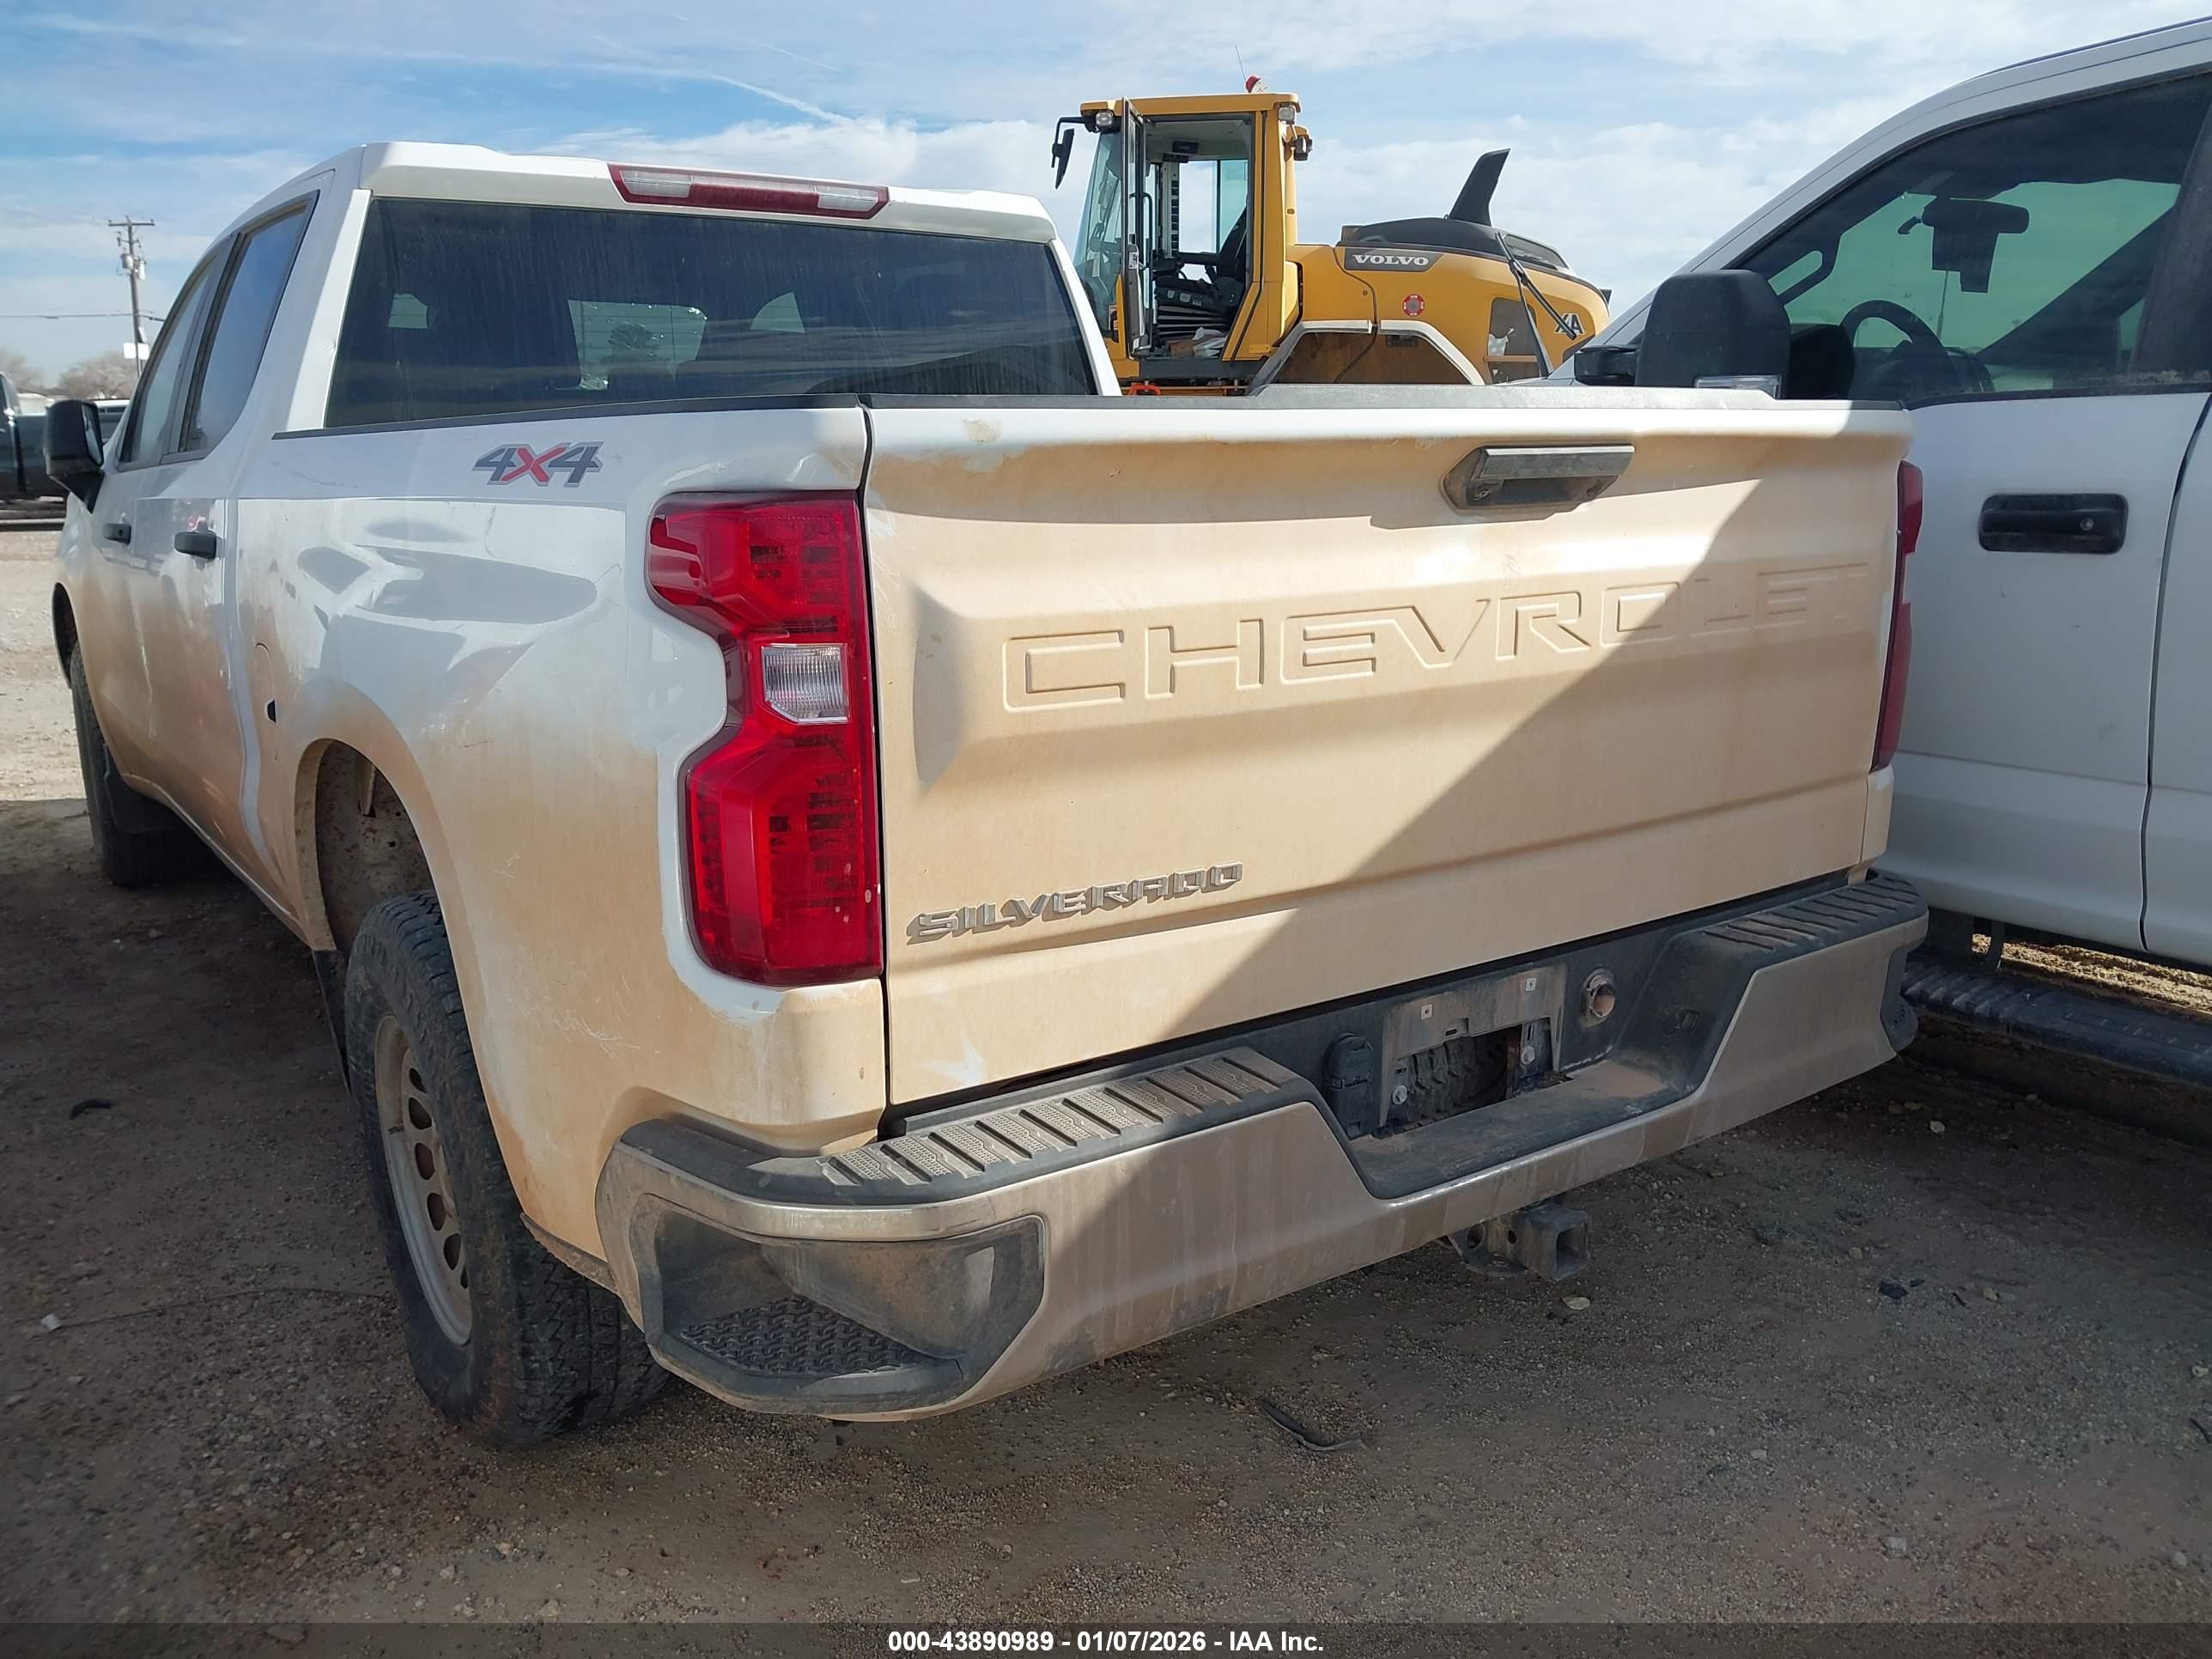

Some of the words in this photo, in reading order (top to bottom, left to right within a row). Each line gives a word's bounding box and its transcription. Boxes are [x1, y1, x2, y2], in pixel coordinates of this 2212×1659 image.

[1352, 254, 1429, 266] VOLVO
[1002, 562, 1870, 713] CHEVROLET
[912, 860, 1243, 939] SILVERADO
